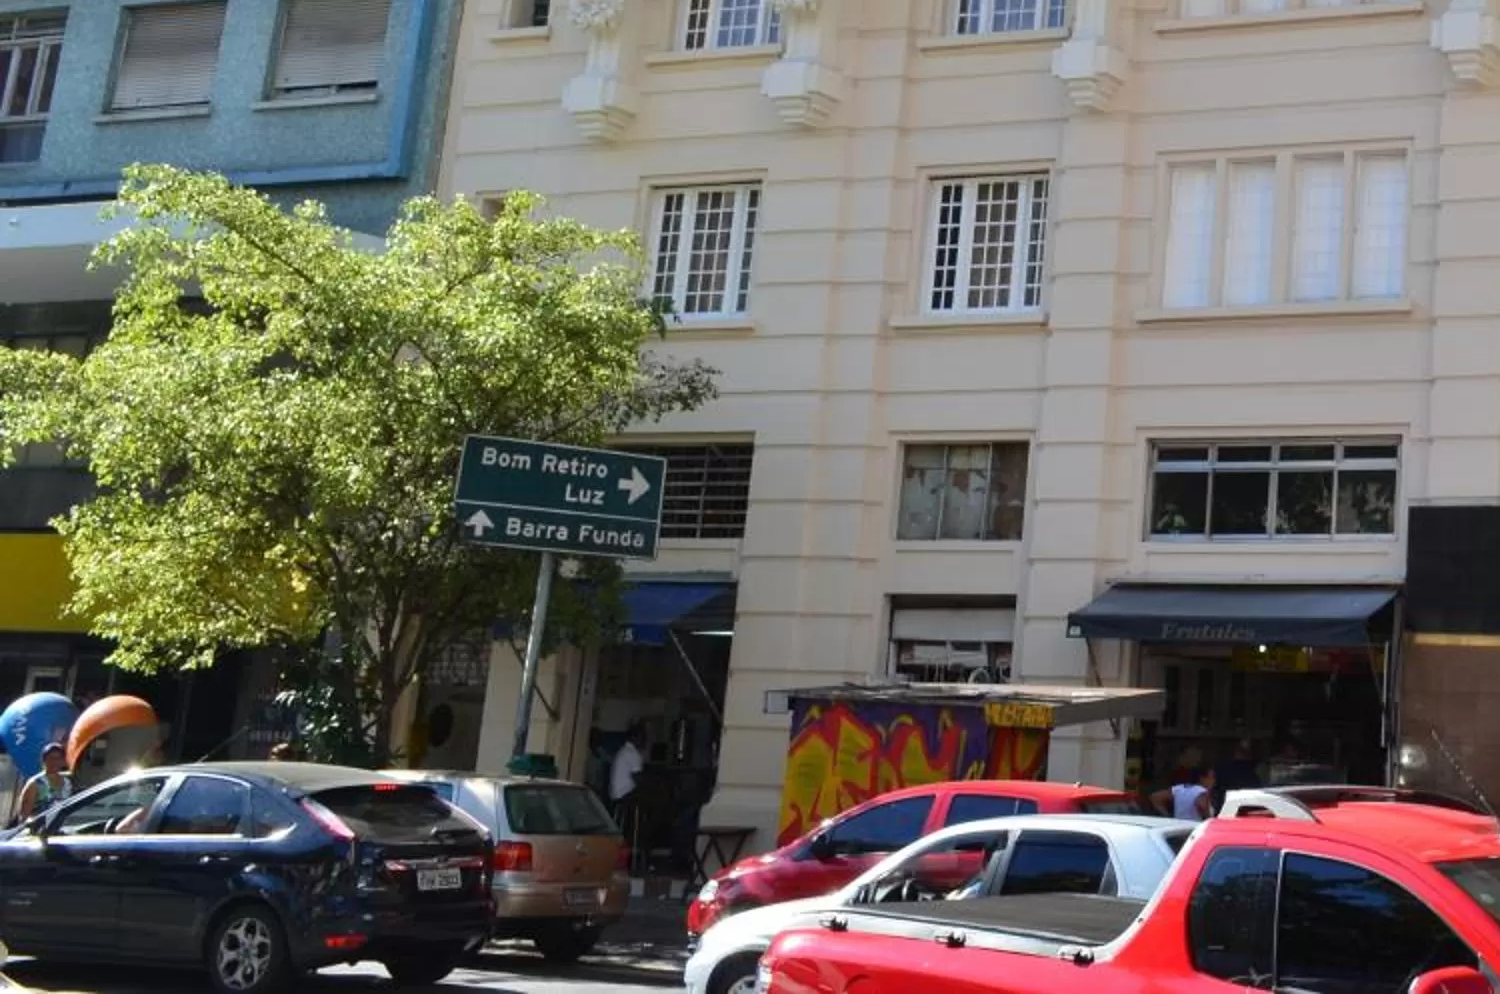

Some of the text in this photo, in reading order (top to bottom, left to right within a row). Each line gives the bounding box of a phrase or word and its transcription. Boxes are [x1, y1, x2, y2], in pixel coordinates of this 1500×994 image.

[480, 446, 609, 479] Bom Retiro
[564, 482, 606, 506] Luz
[505, 516, 646, 548] Barra Funda
